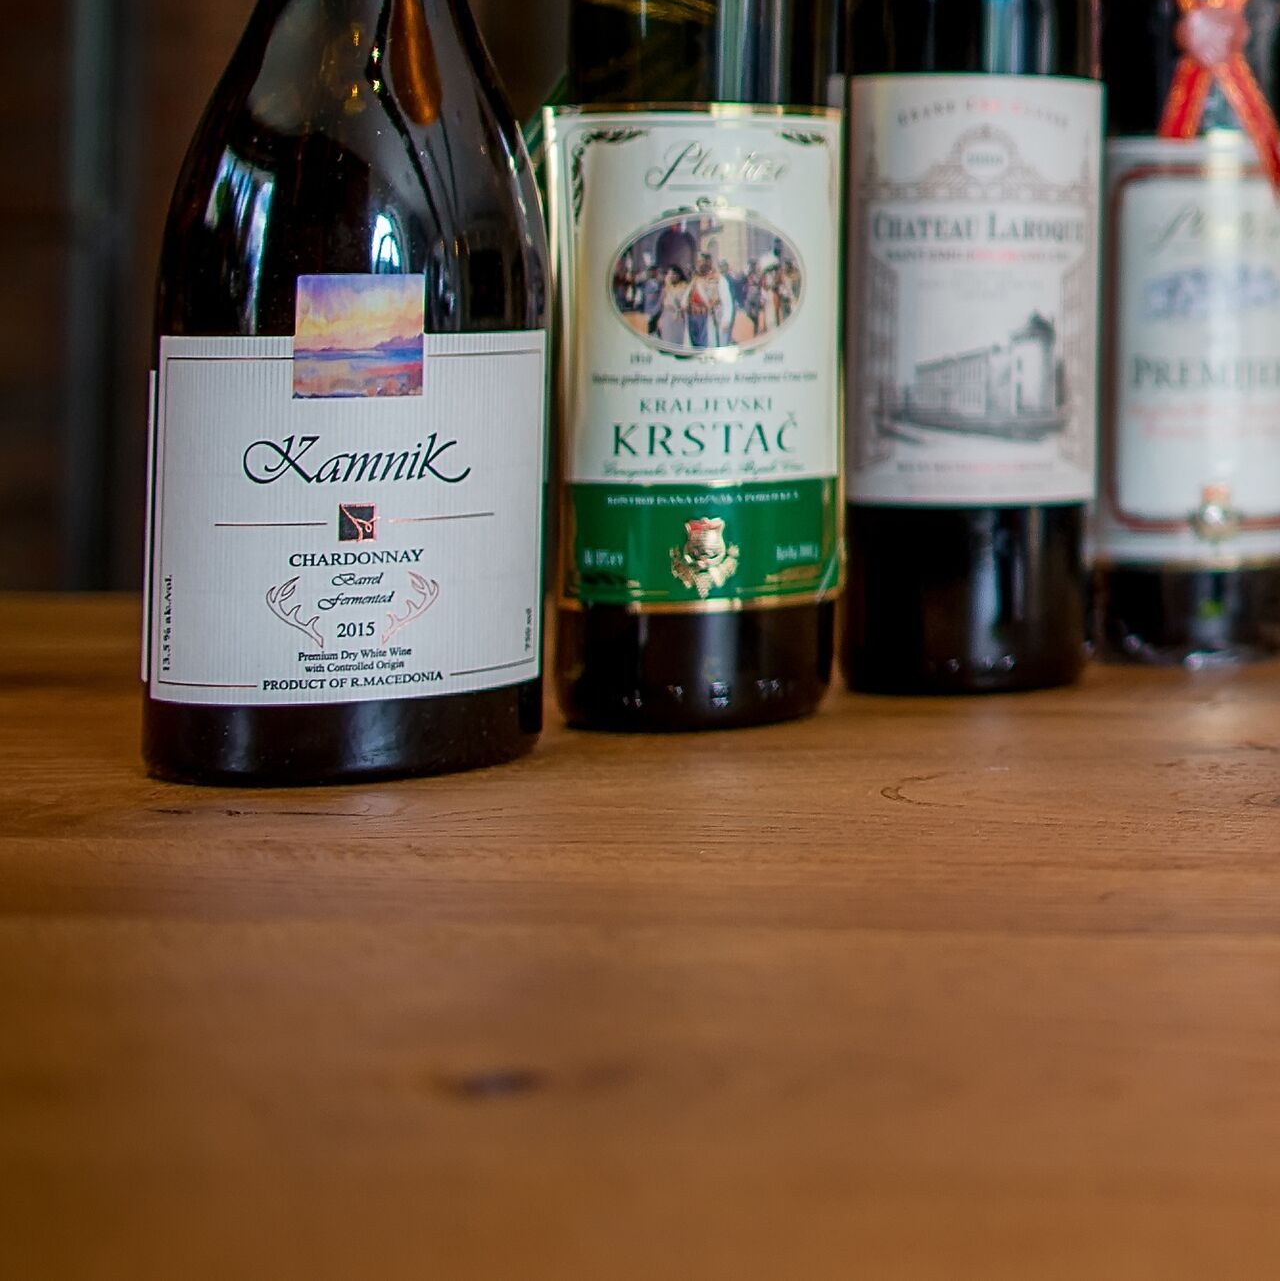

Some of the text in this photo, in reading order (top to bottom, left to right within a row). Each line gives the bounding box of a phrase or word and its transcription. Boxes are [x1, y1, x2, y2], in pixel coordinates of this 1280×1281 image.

[639, 397, 773, 414] KRALJEVSKI
[612, 411, 798, 457] KRSTAČ
[243, 432, 471, 484] Kamnik
[288, 549, 424, 567] CHARDONNAY
[331, 572, 384, 587] Barrel
[317, 590, 395, 610] Fermented
[336, 622, 375, 638] 2015
[298, 647, 412, 662] Premium Dry White Wine
[305, 659, 405, 674] with Controlled Origin
[262, 670, 443, 691] PRODUCT OF R.MACEDONIA
